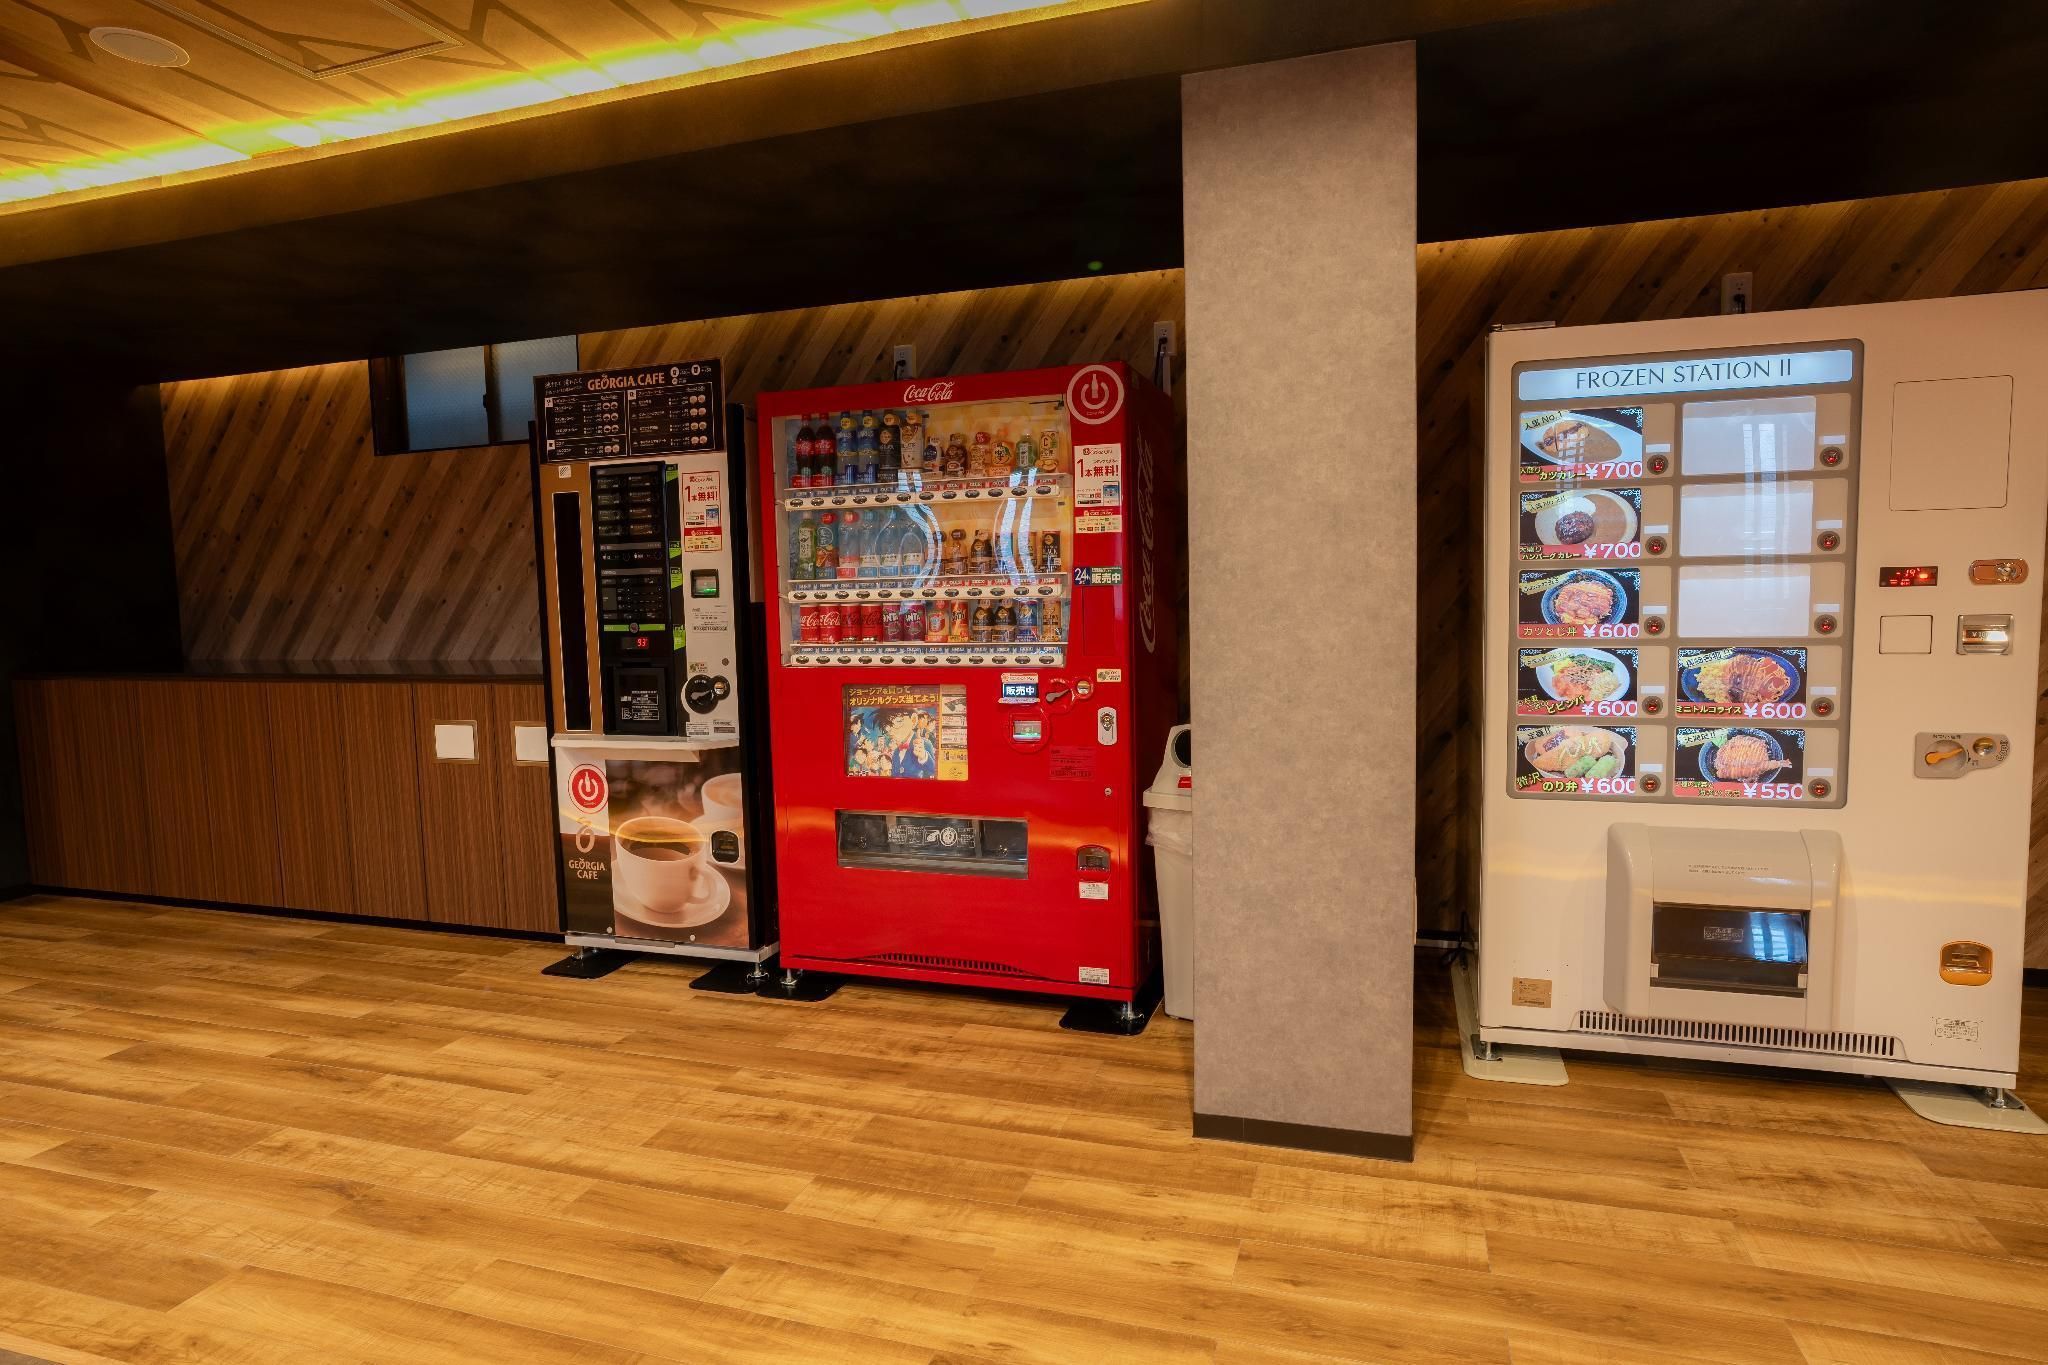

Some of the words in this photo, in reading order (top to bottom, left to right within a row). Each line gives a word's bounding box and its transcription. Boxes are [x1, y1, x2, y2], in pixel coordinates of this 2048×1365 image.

[637, 372, 665, 386] CAFE
[1575, 368, 1665, 390] FROZEN
[1674, 359, 1771, 383] STATION
[904, 382, 955, 403] Coca-Cola
[1077, 459, 1119, 477] 1本無料!
[1585, 463, 1643, 480] ¥700
[1540, 471, 1586, 481] カツカレー
[685, 485, 719, 503] 1本無料!
[1584, 543, 1641, 559] ¥700
[1091, 573, 1121, 584] 販売中
[1523, 627, 1577, 637] カツとじ丼
[1582, 624, 1640, 639] ¥600
[1006, 686, 1035, 696] 販売中
[849, 694, 939, 706] オリジナルグッズ当てよう!
[1581, 700, 1638, 716] ¥600
[1676, 704, 1742, 715] ミニトルコライス
[1743, 702, 1807, 719] ¥600
[1542, 780, 1579, 792] のり弁
[1580, 778, 1636, 794] ¥600
[1743, 782, 1803, 800] ¥550
[577, 869, 599, 880] CAFE
